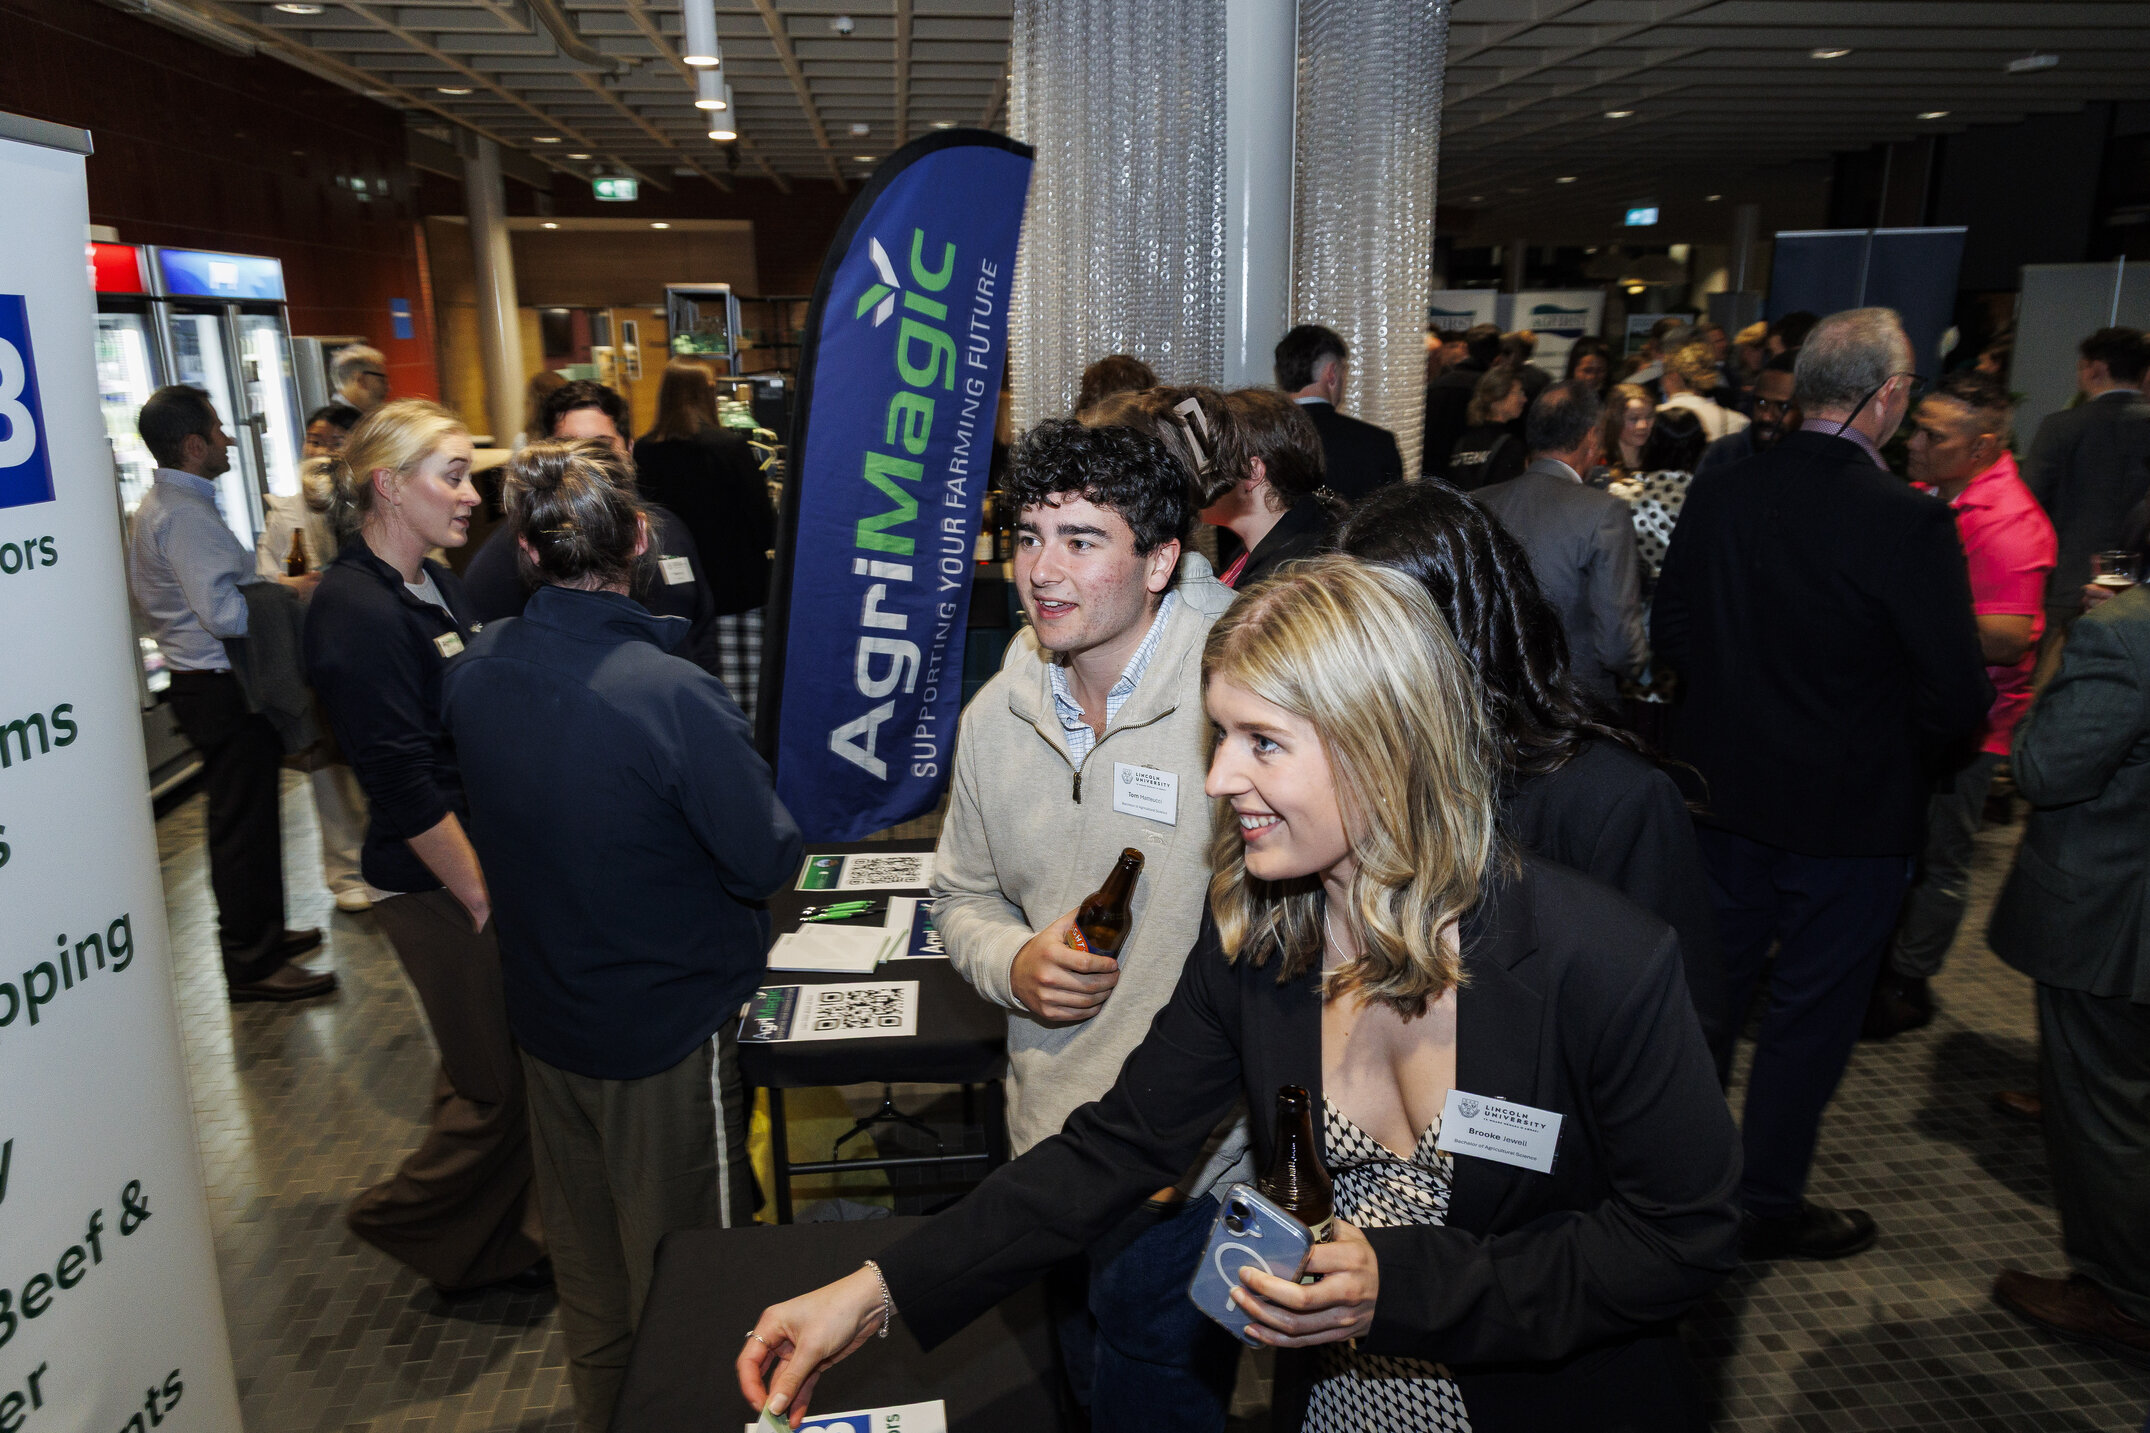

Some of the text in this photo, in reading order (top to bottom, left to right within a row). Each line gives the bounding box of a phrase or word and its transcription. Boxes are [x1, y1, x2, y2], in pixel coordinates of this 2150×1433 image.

[828, 227, 957, 781] AgriMagic
[911, 258, 998, 778] SUPPORTING YOUR FARMING FUTURE
[1136, 772, 1160, 780] LINCOLN
[1136, 777, 1171, 788] UNIVERSITY
[1128, 791, 1139, 799] Tom
[752, 989, 784, 1040] AgriMagic
[1484, 1111, 1546, 1129] UNIVERSITY
[1485, 1105, 1528, 1119] LINCOLN
[1468, 1127, 1528, 1147] Brooke Jewell
[1454, 1138, 1478, 1148] Bachelor
[1484, 1144, 1515, 1157] Agricultural
[1515, 1152, 1538, 1162] Science
[120, 1179, 152, 1236] &
